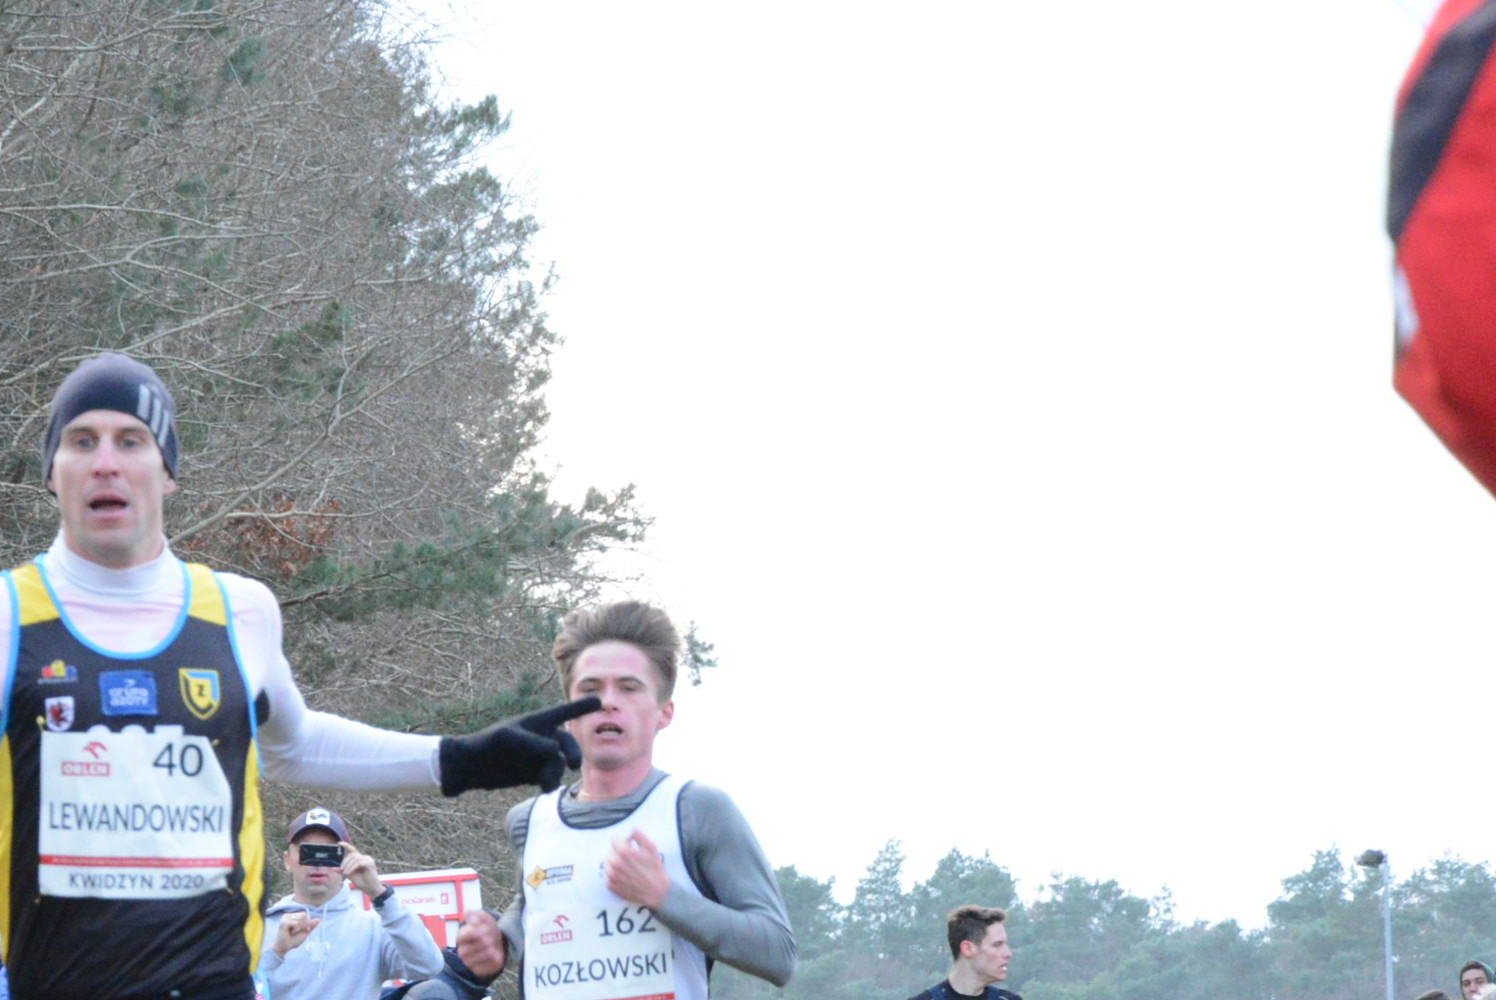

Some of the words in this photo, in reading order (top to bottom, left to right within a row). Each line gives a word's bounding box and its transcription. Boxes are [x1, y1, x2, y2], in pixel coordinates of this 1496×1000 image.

[62, 762, 109, 775] ORLEN
[152, 742, 205, 778] 40
[48, 801, 224, 833] LEWANDOWSKI
[68, 872, 154, 890] KWIDZYN
[160, 873, 204, 890] 2020
[540, 930, 572, 944] ORLEN
[595, 905, 657, 938] 162
[534, 952, 668, 989] KOZŁOWSKI
